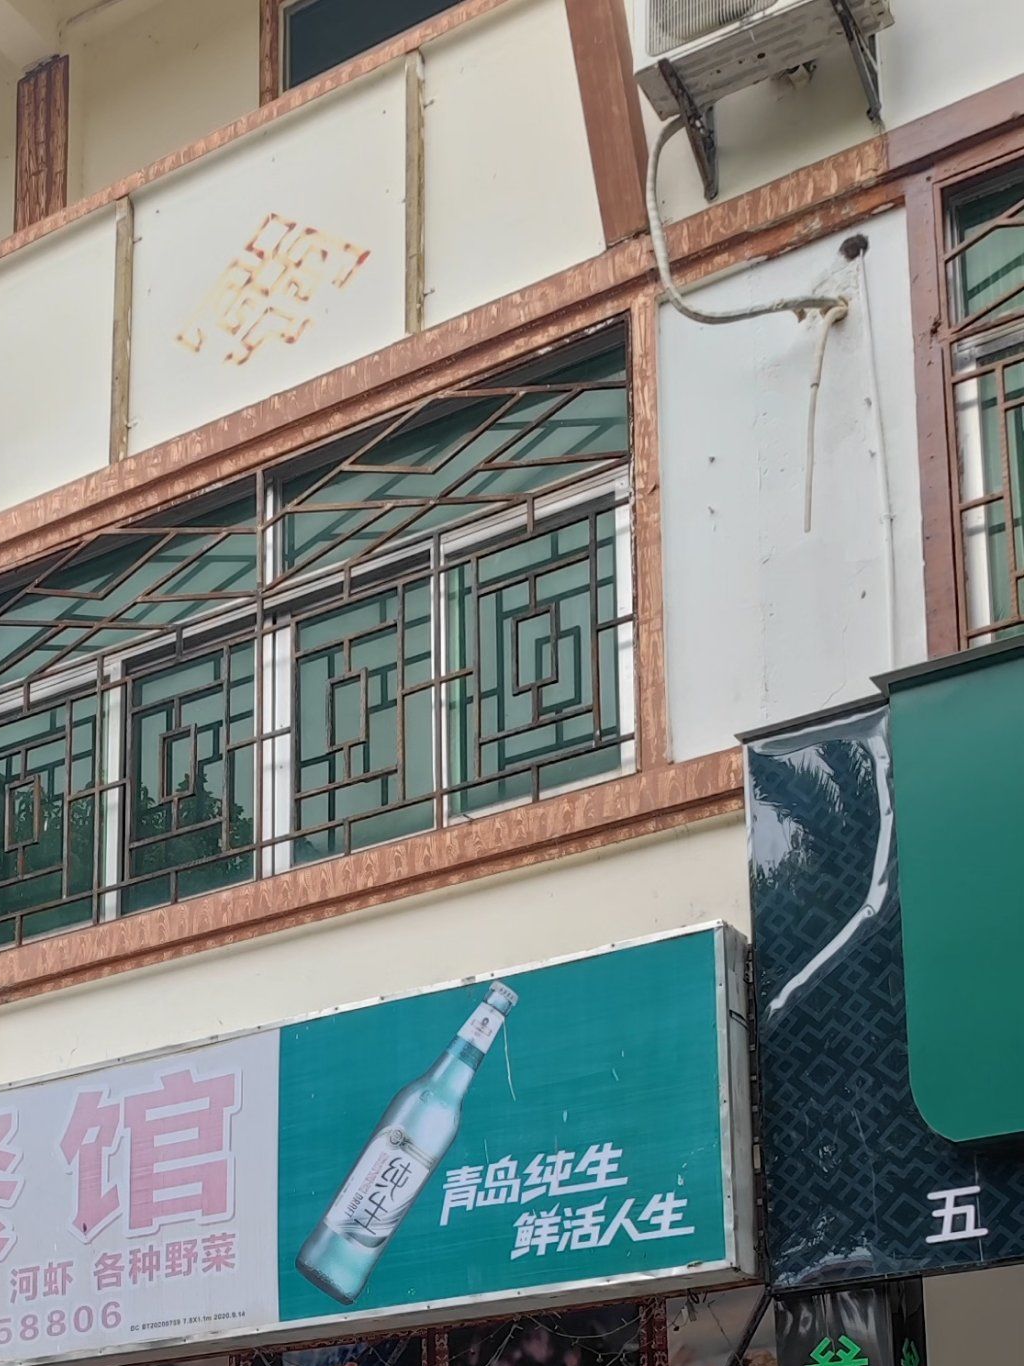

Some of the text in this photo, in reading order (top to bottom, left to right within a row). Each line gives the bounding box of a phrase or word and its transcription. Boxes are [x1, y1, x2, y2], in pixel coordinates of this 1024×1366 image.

[440, 1142, 629, 1226] 青岛纯生
[925, 1185, 988, 1244] 五
[510, 1190, 695, 1261] 鲜活人生
[10, 1258, 74, 1303] 河虾
[93, 1231, 237, 1292] 各种野菜
